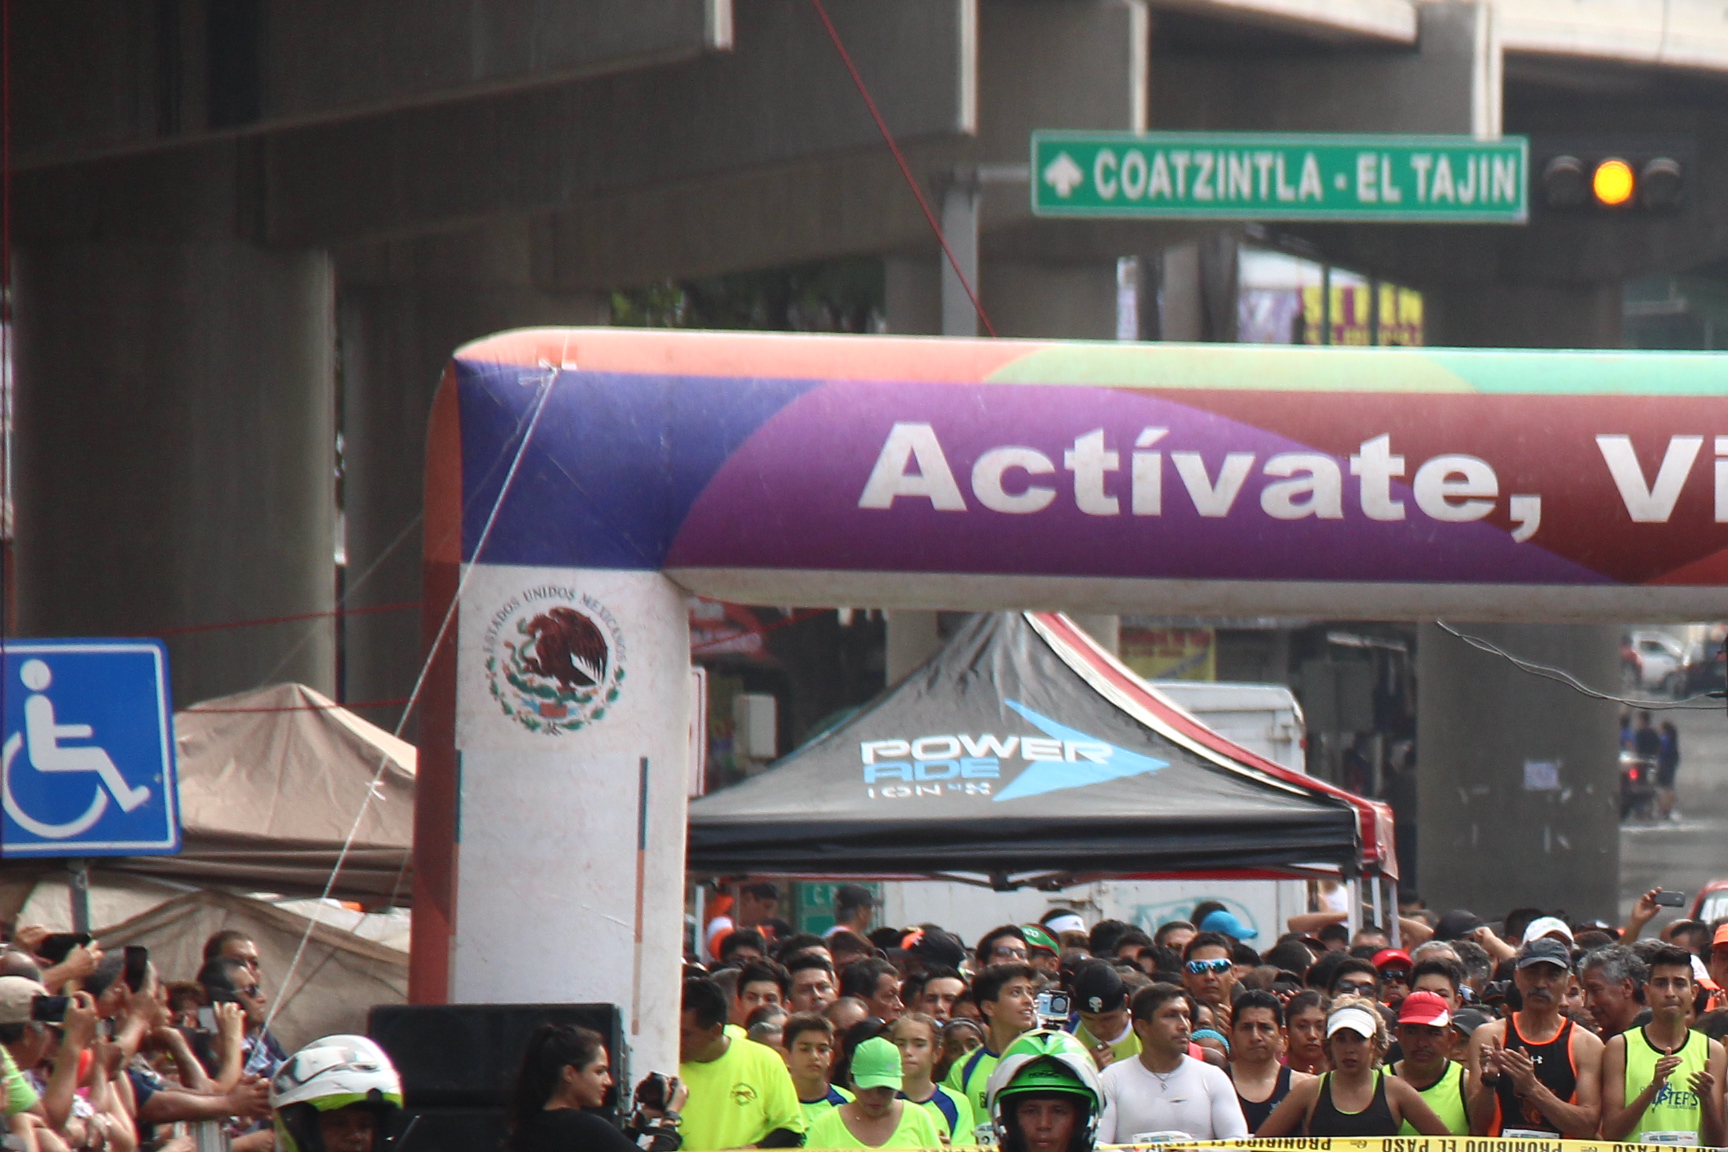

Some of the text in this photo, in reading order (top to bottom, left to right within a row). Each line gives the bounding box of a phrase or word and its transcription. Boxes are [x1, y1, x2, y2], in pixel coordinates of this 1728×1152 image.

[1093, 150, 1324, 201] COATZINTLA
[1356, 154, 1402, 202] EL
[1411, 154, 1517, 204] TAJIN
[858, 421, 1542, 543] Actívate,
[483, 598, 520, 654] ESTADOS
[523, 587, 575, 601] UNIDOS
[860, 733, 1114, 764] POWER
[863, 757, 1000, 783] ADE
